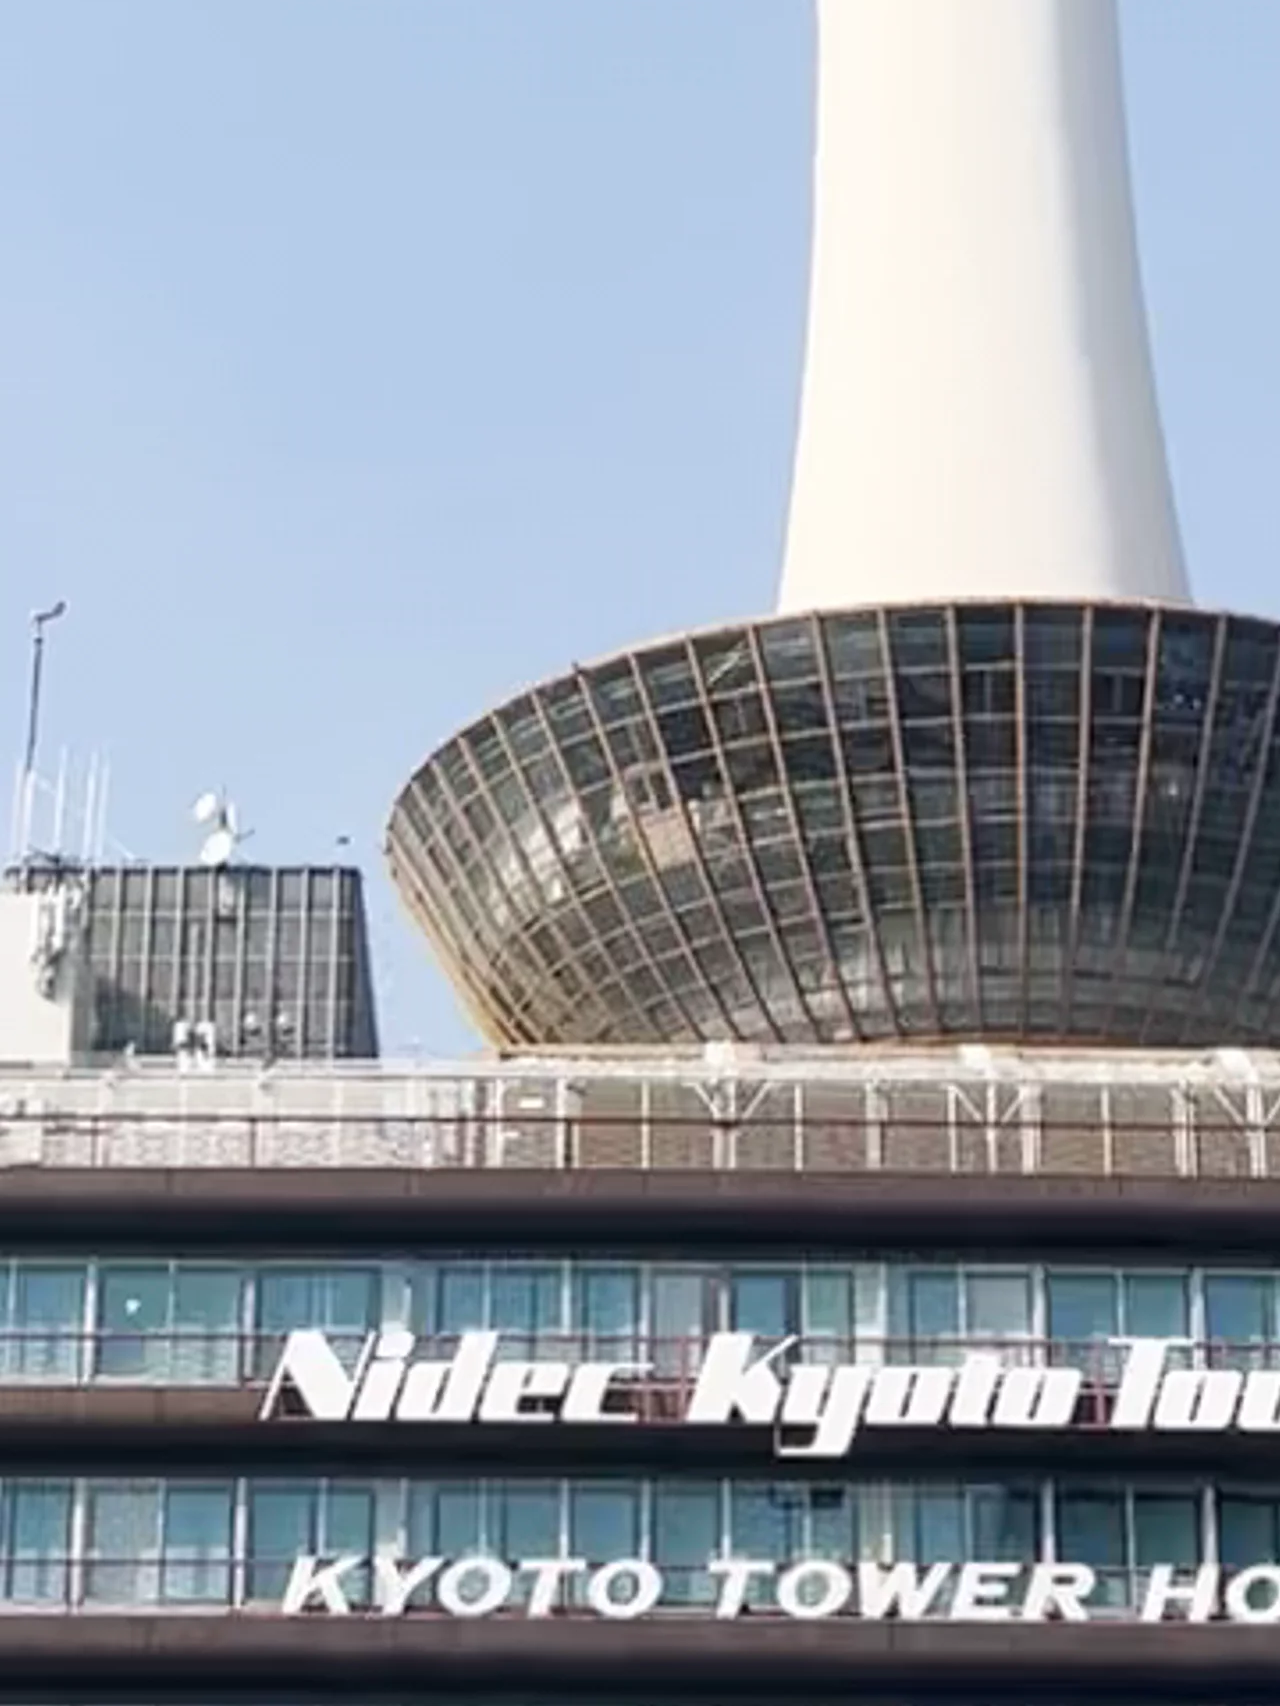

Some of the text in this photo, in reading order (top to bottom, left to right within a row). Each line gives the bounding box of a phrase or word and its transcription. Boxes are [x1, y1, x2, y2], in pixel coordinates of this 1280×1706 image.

[259, 1321, 654, 1422] Nidec
[687, 1332, 1081, 1456] Kyoto
[281, 1555, 664, 1619] KYOTO
[706, 1560, 1096, 1622] TOWER
